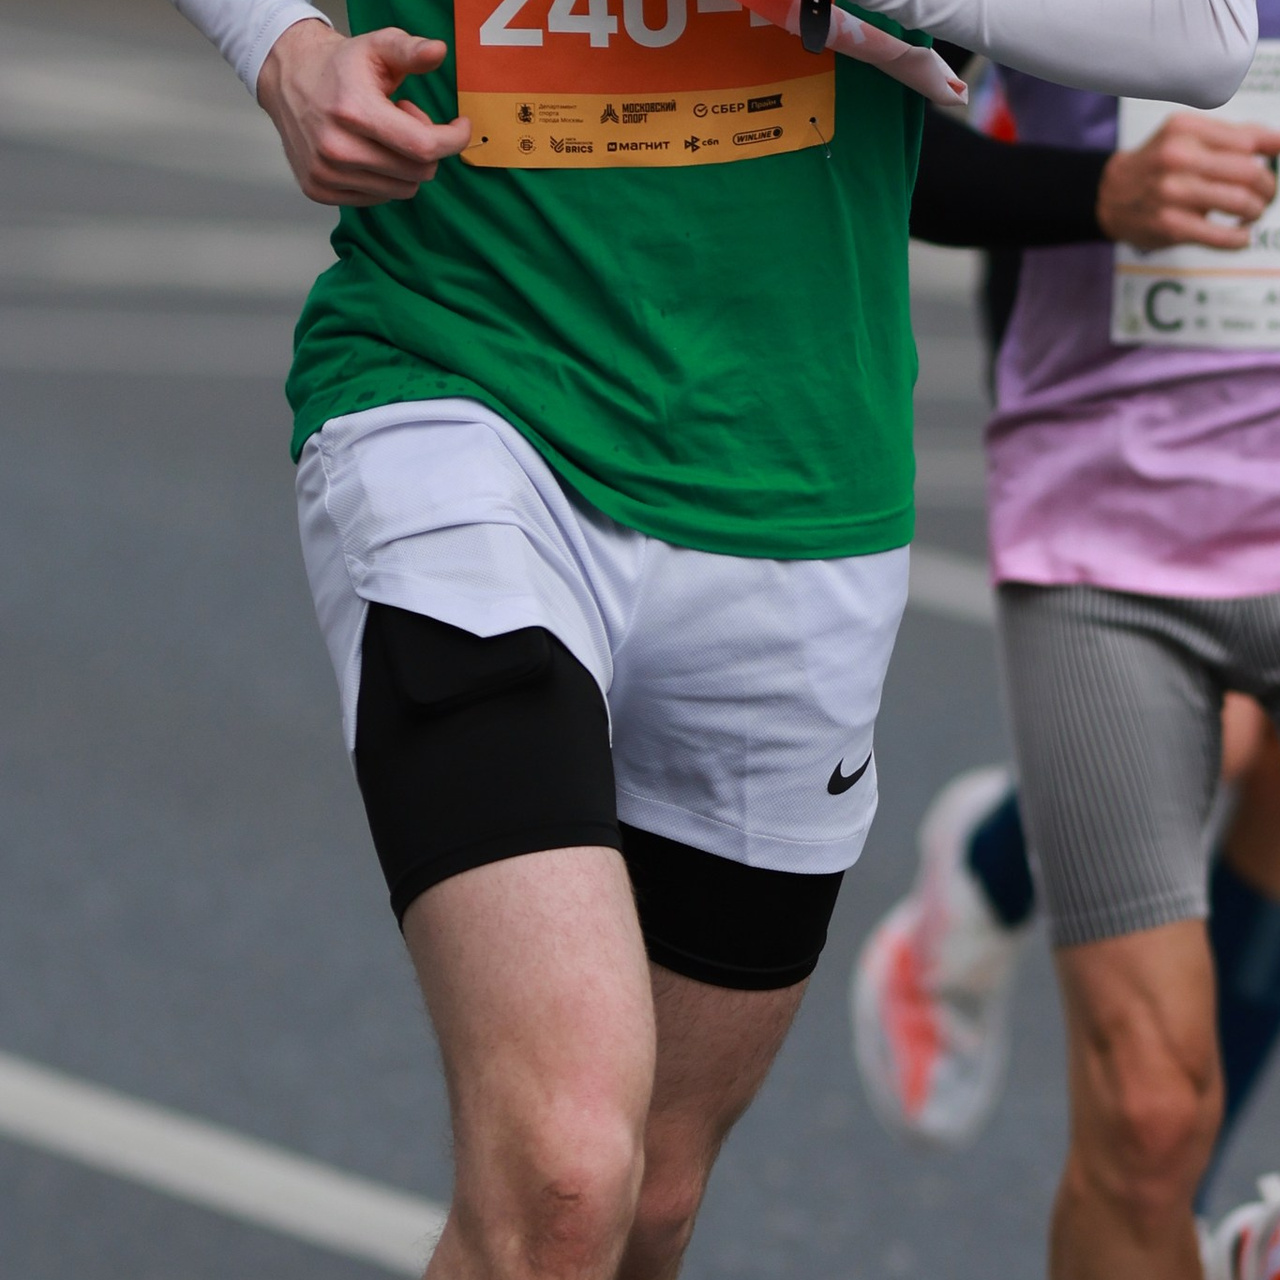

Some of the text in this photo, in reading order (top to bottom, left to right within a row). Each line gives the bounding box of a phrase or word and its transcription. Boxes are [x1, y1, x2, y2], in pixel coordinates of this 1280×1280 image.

[622, 99, 677, 114] МОСКОВСКИЙ
[711, 102, 745, 115] СБЕР
[622, 112, 648, 124] СПОРТ
[736, 130, 773, 143] WINLINE
[565, 145, 594, 154] BRICS
